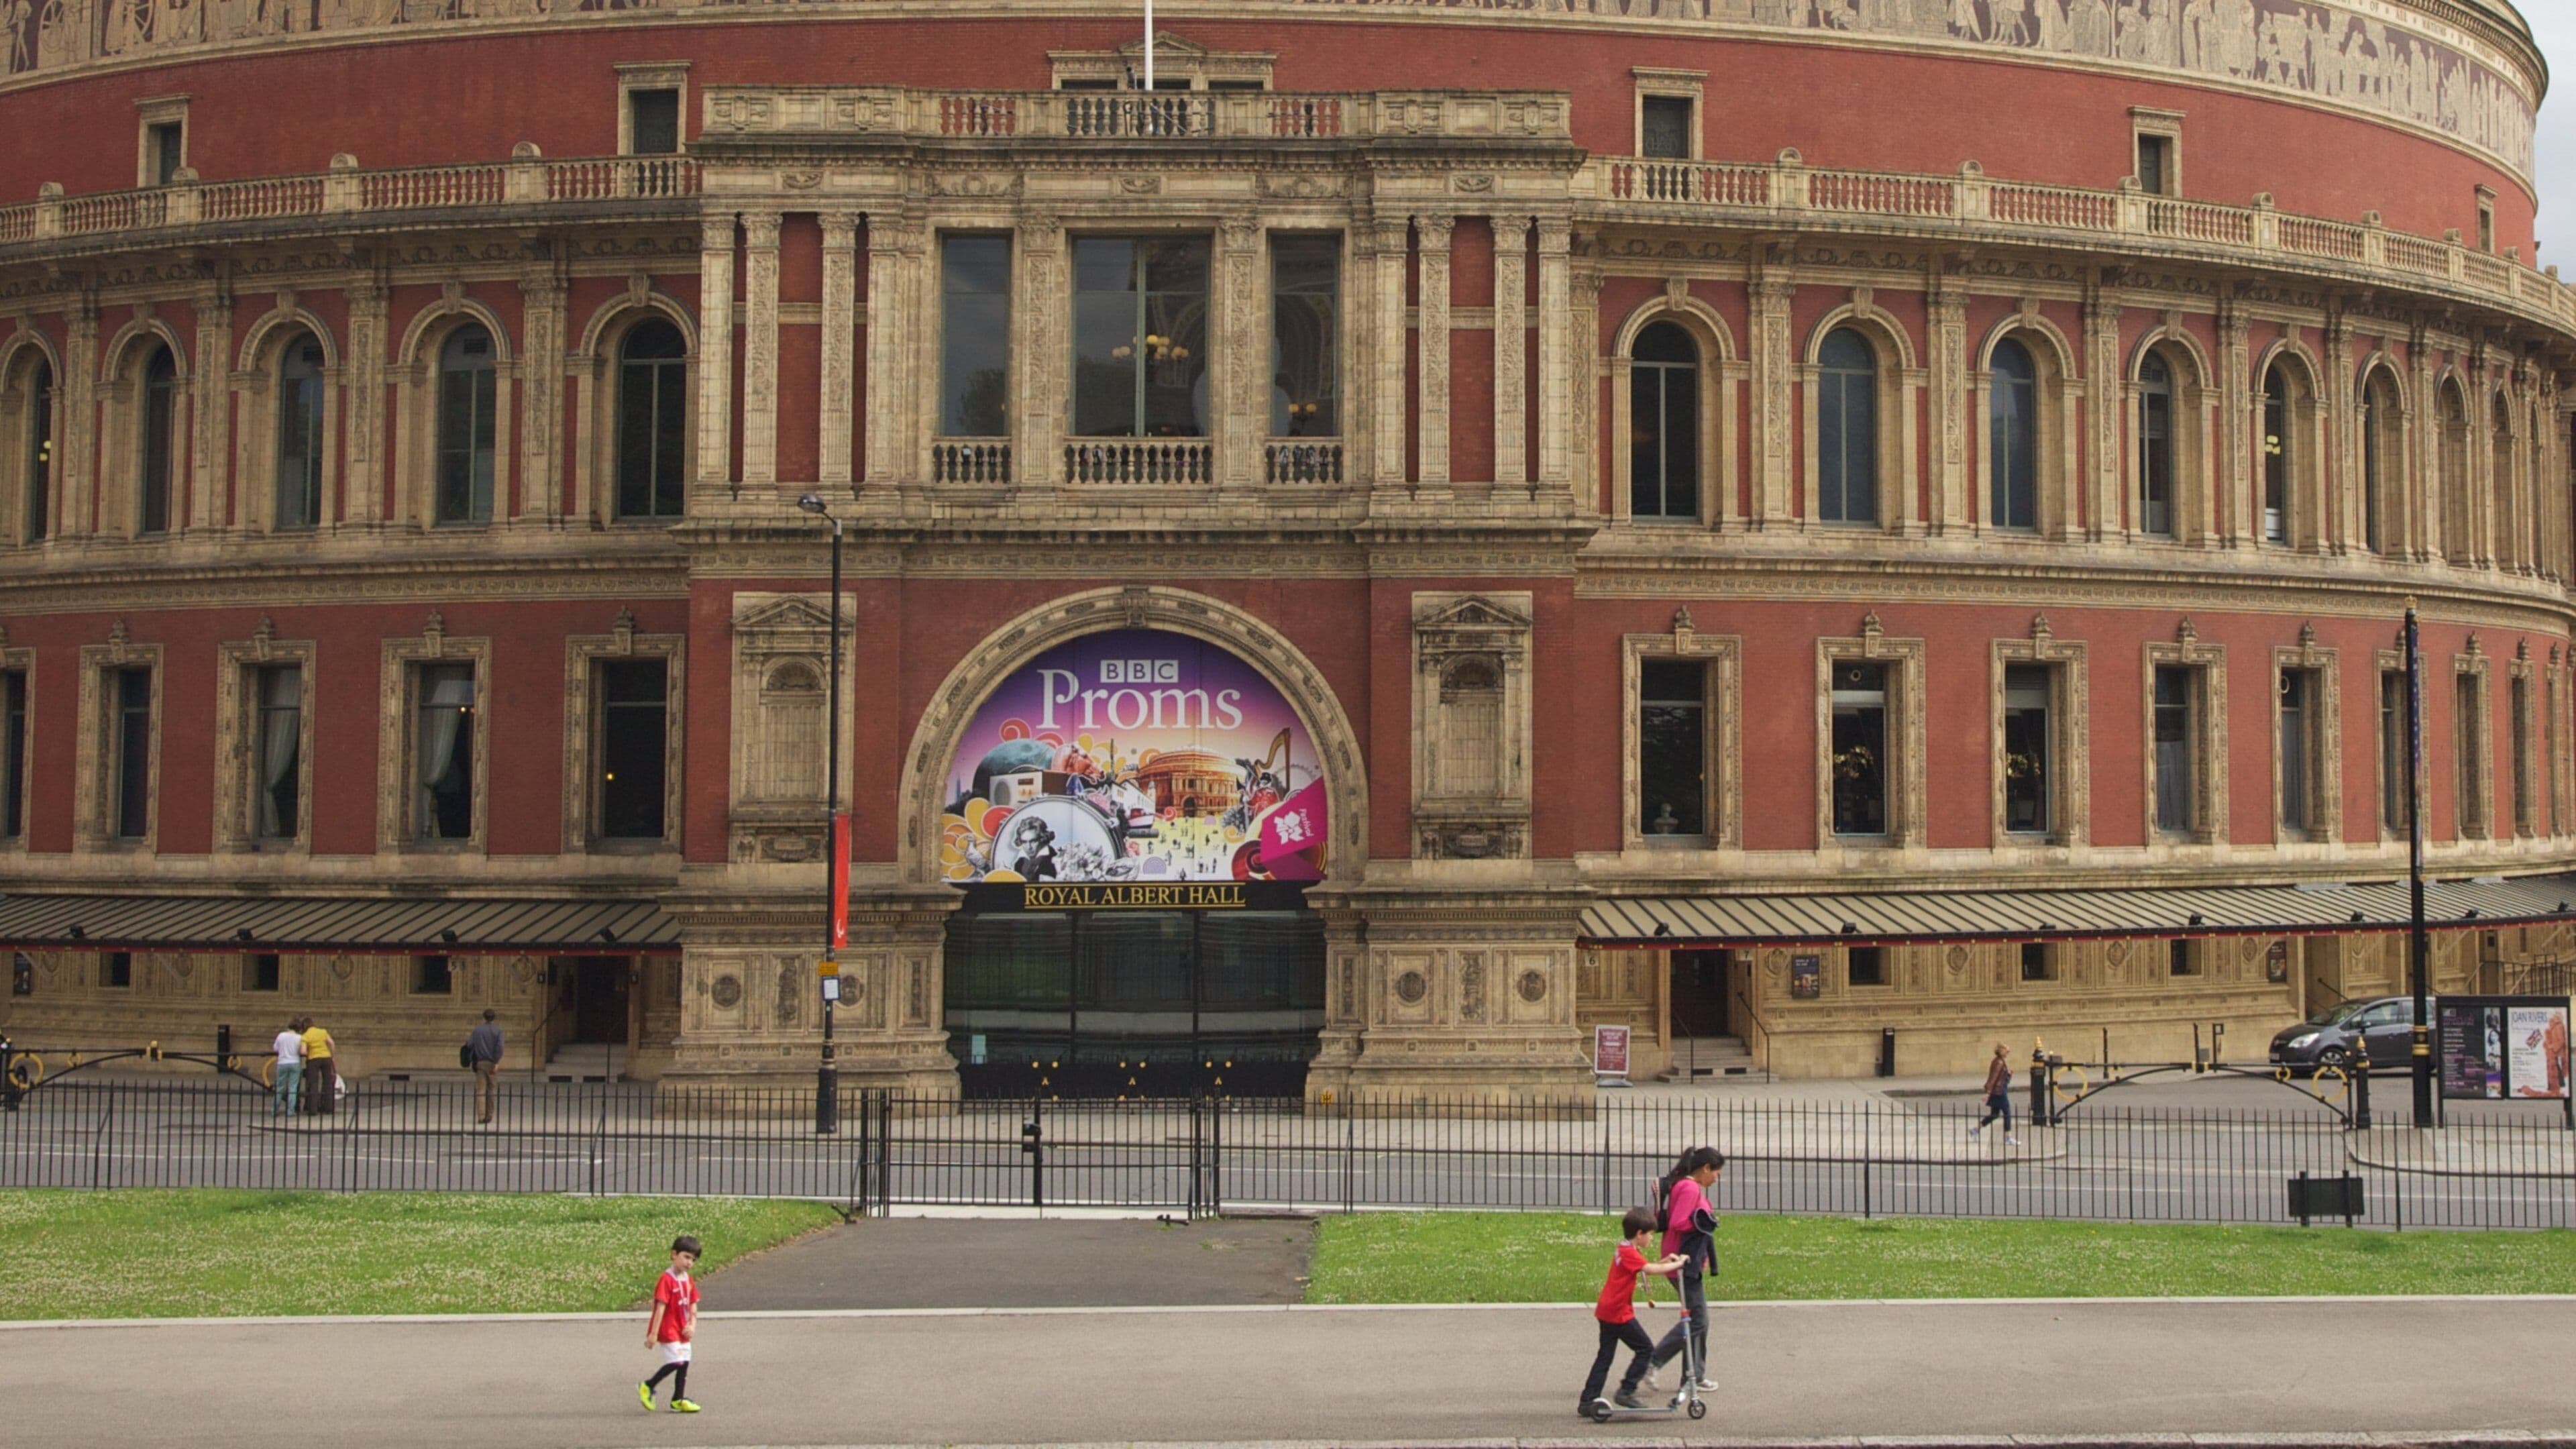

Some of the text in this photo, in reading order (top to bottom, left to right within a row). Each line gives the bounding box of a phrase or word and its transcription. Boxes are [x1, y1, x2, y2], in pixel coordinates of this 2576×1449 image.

[1102, 661, 1177, 682] BBC
[1035, 669, 1243, 730] Proms
[1299, 808, 1314, 837] Festival
[1024, 886, 1245, 905] ROYAL ALBERT HALL
[1589, 955, 1596, 965] 6
